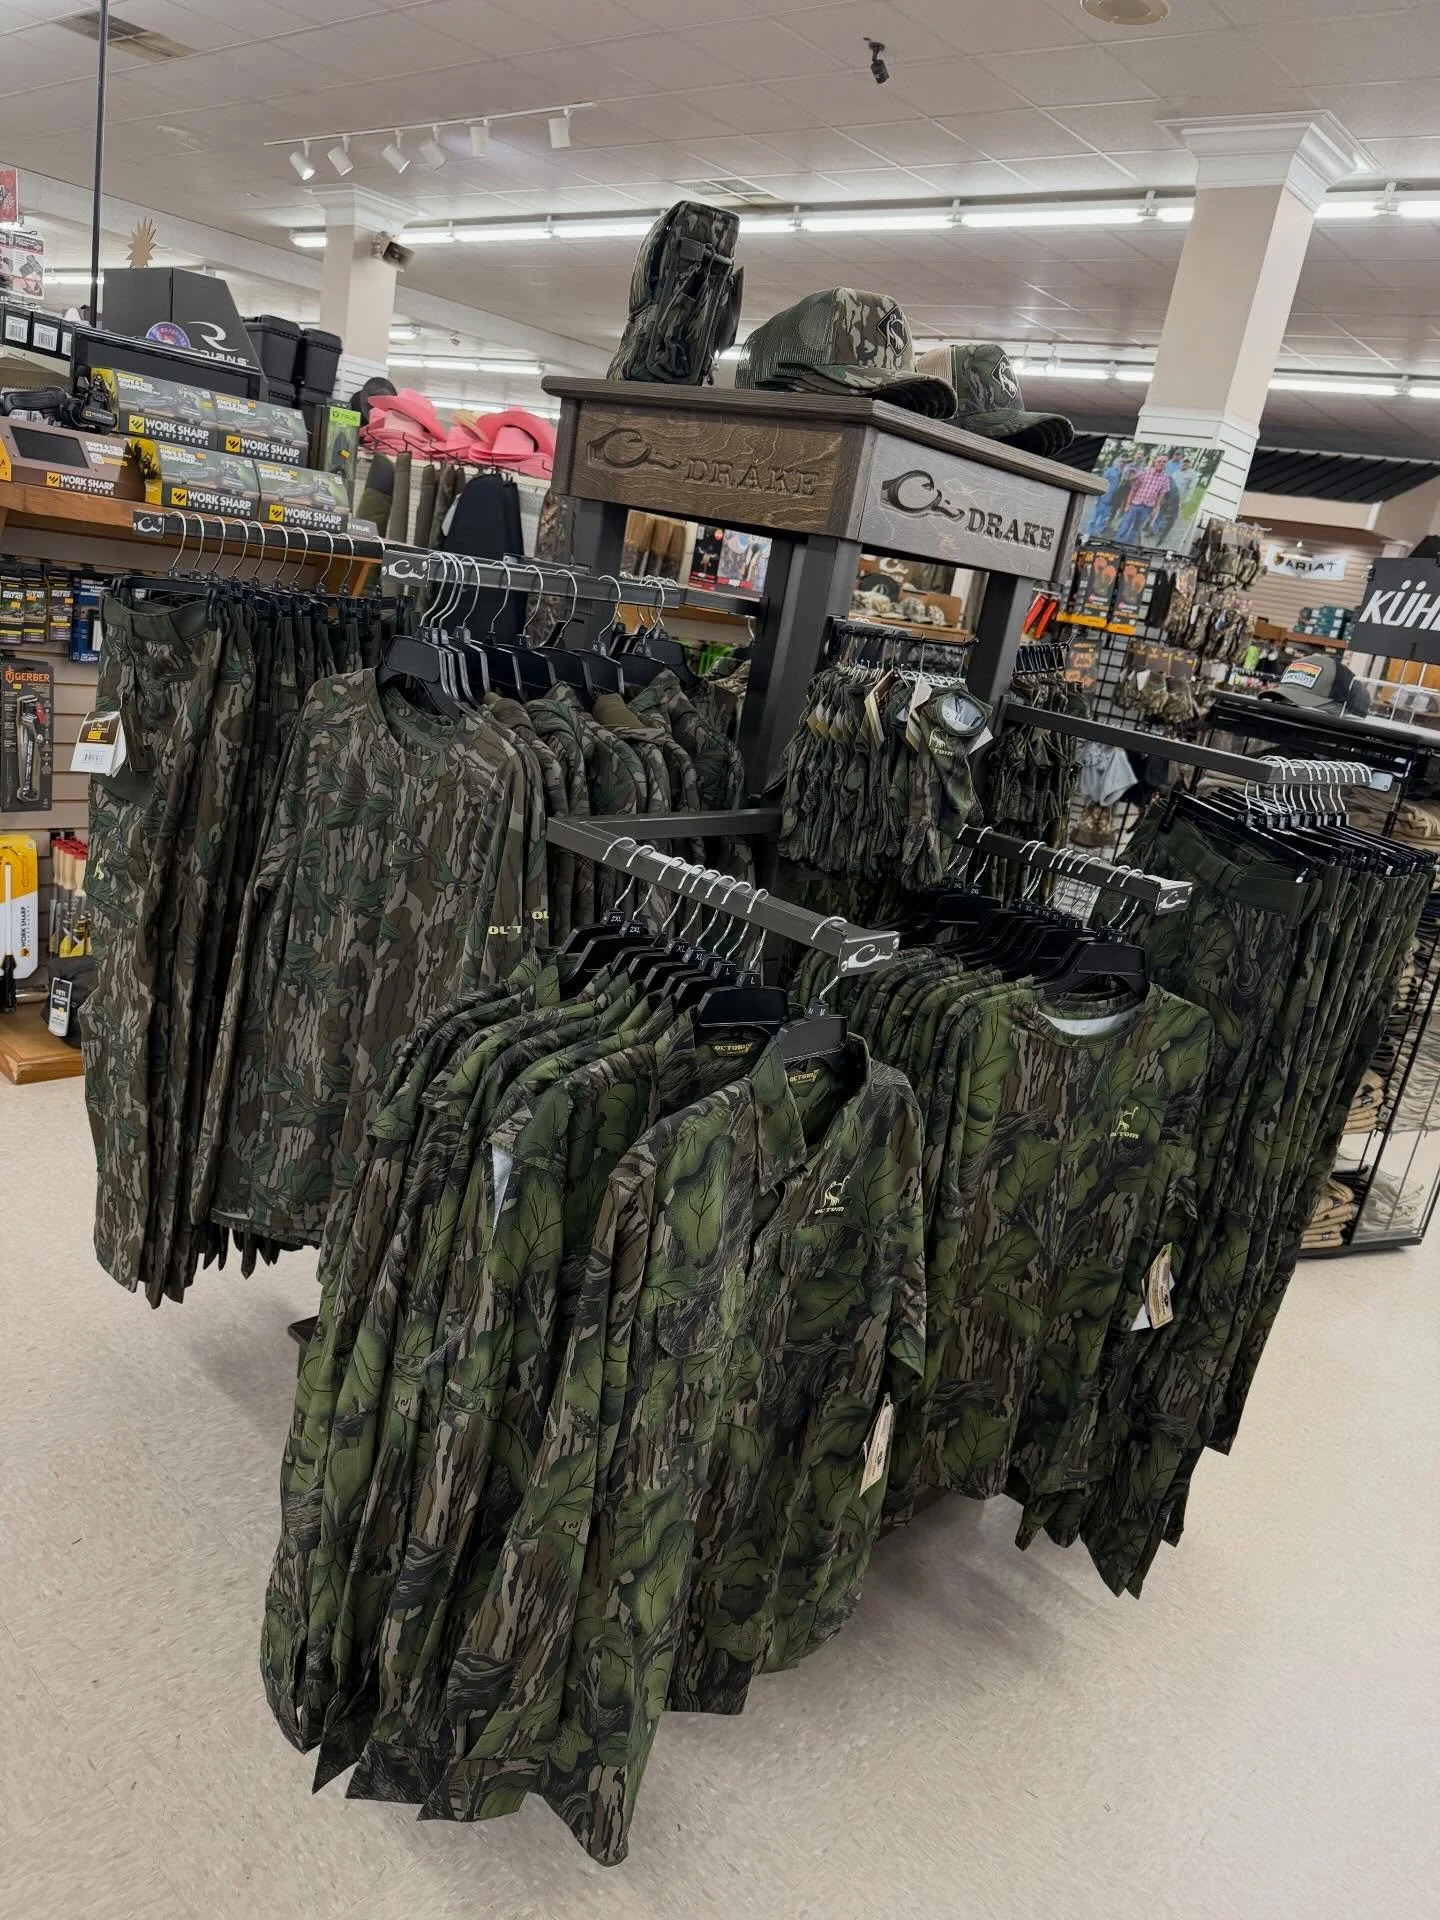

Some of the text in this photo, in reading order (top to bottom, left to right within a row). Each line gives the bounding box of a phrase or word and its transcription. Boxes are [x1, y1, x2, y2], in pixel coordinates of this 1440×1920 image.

[145, 418, 209, 439] WORK SHARP
[145, 428, 208, 445] SHARPENERS
[241, 438, 299, 456] WORK SHARP
[241, 448, 299, 464] SHARPENERS
[60, 474, 114, 490] WORK SHARP
[683, 456, 820, 498] DRAKE
[60, 482, 114, 496] SHARPENERS
[187, 491, 251, 510] WORK SHARP
[187, 502, 250, 516] SHARPENERS
[284, 507, 342, 524] WORK SHARP
[284, 517, 341, 531] SHARPENERS
[965, 508, 1055, 551] DRAKE
[1285, 560, 1337, 572] ARIAT
[15, 672, 50, 682] GERBER
[675, 944, 686, 953] XL
[725, 967, 731, 976] L
[750, 976, 756, 985] L
